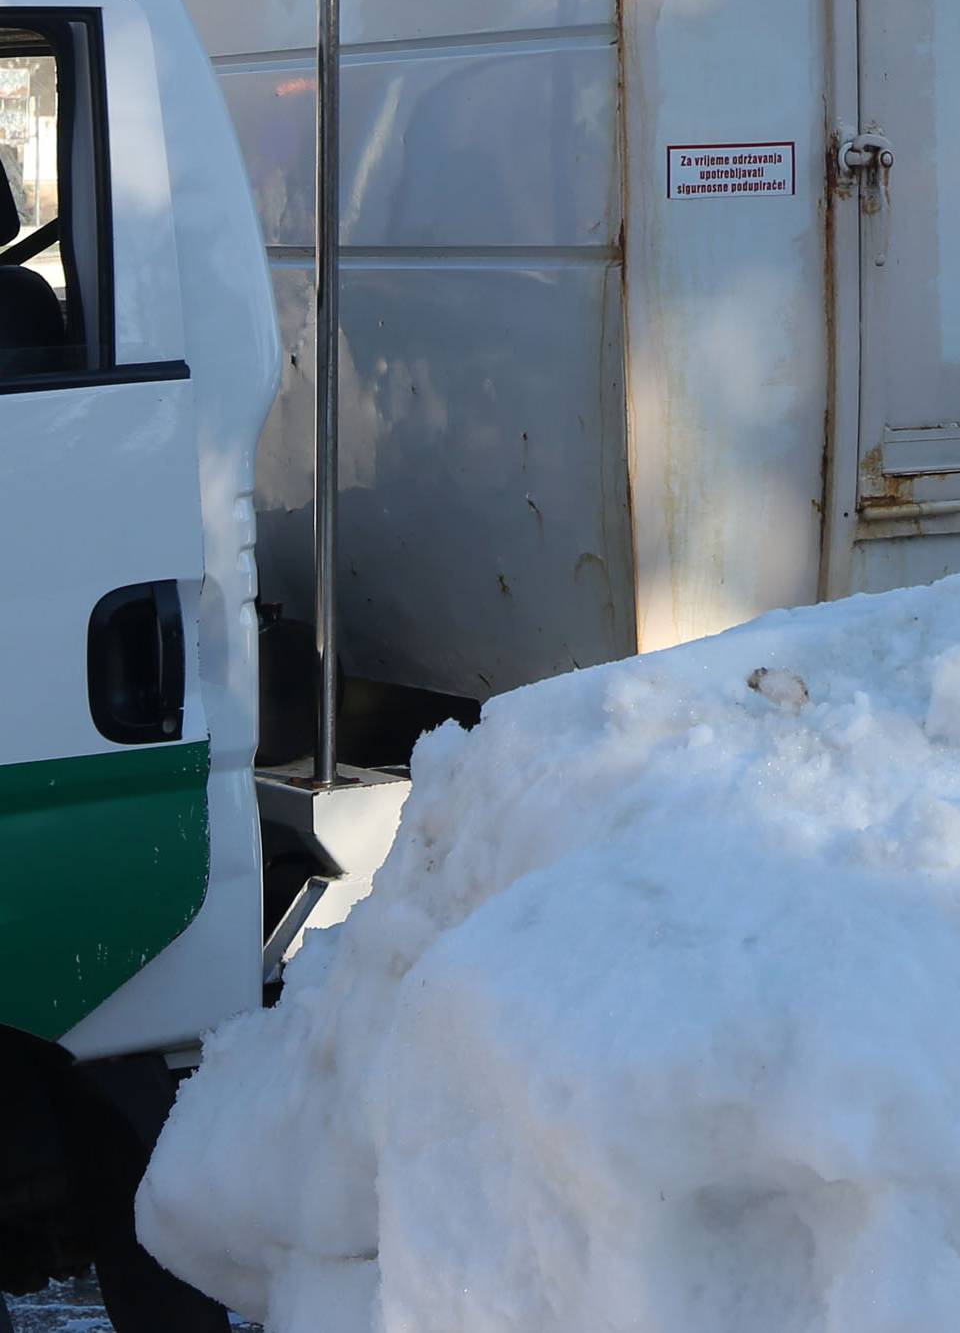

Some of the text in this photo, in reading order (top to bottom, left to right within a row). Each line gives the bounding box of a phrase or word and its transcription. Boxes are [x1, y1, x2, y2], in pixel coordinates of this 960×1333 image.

[680, 153, 782, 167] Za vrijeme održavanja
[700, 167, 764, 181] upotrebljavati
[677, 179, 786, 195] sigurnosne podupirače!
